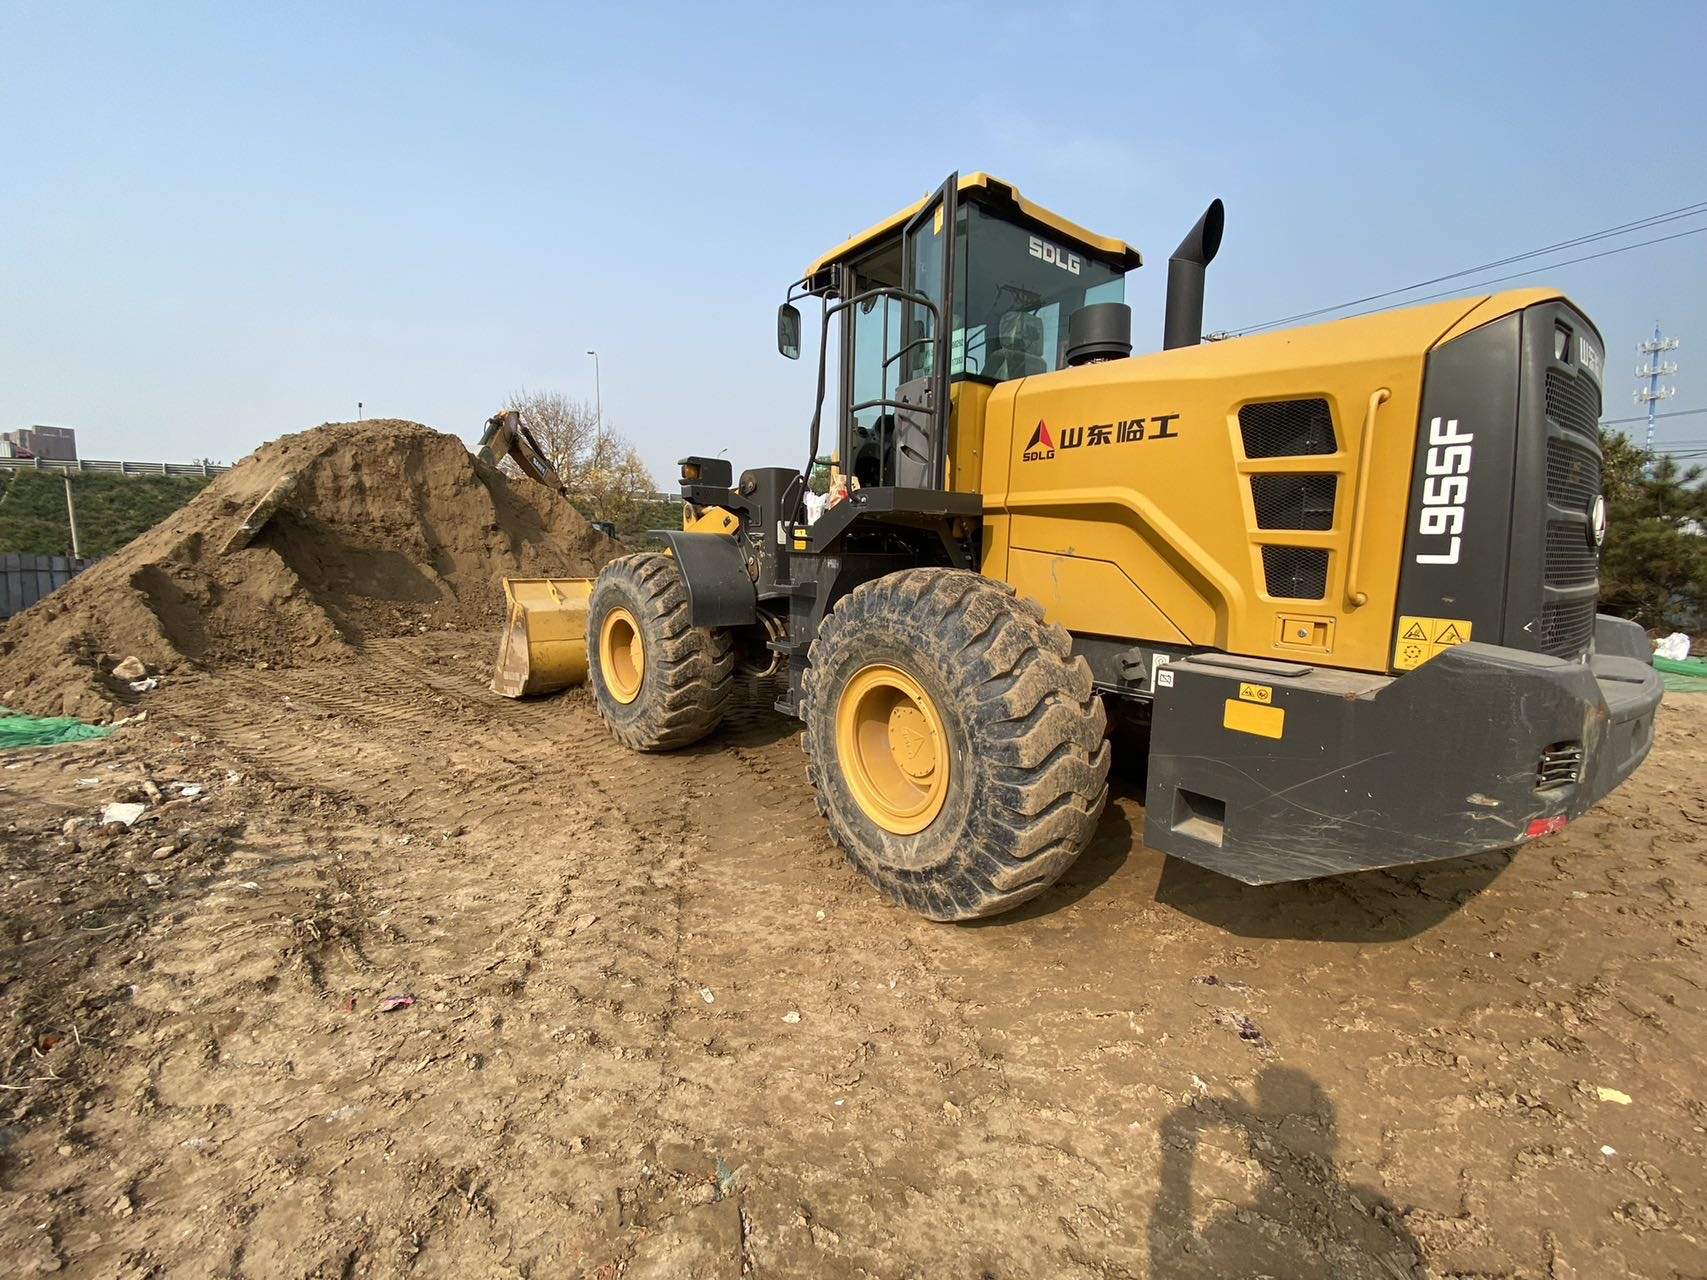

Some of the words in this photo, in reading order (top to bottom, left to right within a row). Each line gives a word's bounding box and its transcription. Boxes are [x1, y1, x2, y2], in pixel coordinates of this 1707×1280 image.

[1029, 235, 1080, 275] SDLG
[1060, 414, 1180, 449] 山东临工
[1022, 450, 1055, 462] SDLG
[1416, 416, 1474, 565] L955F
